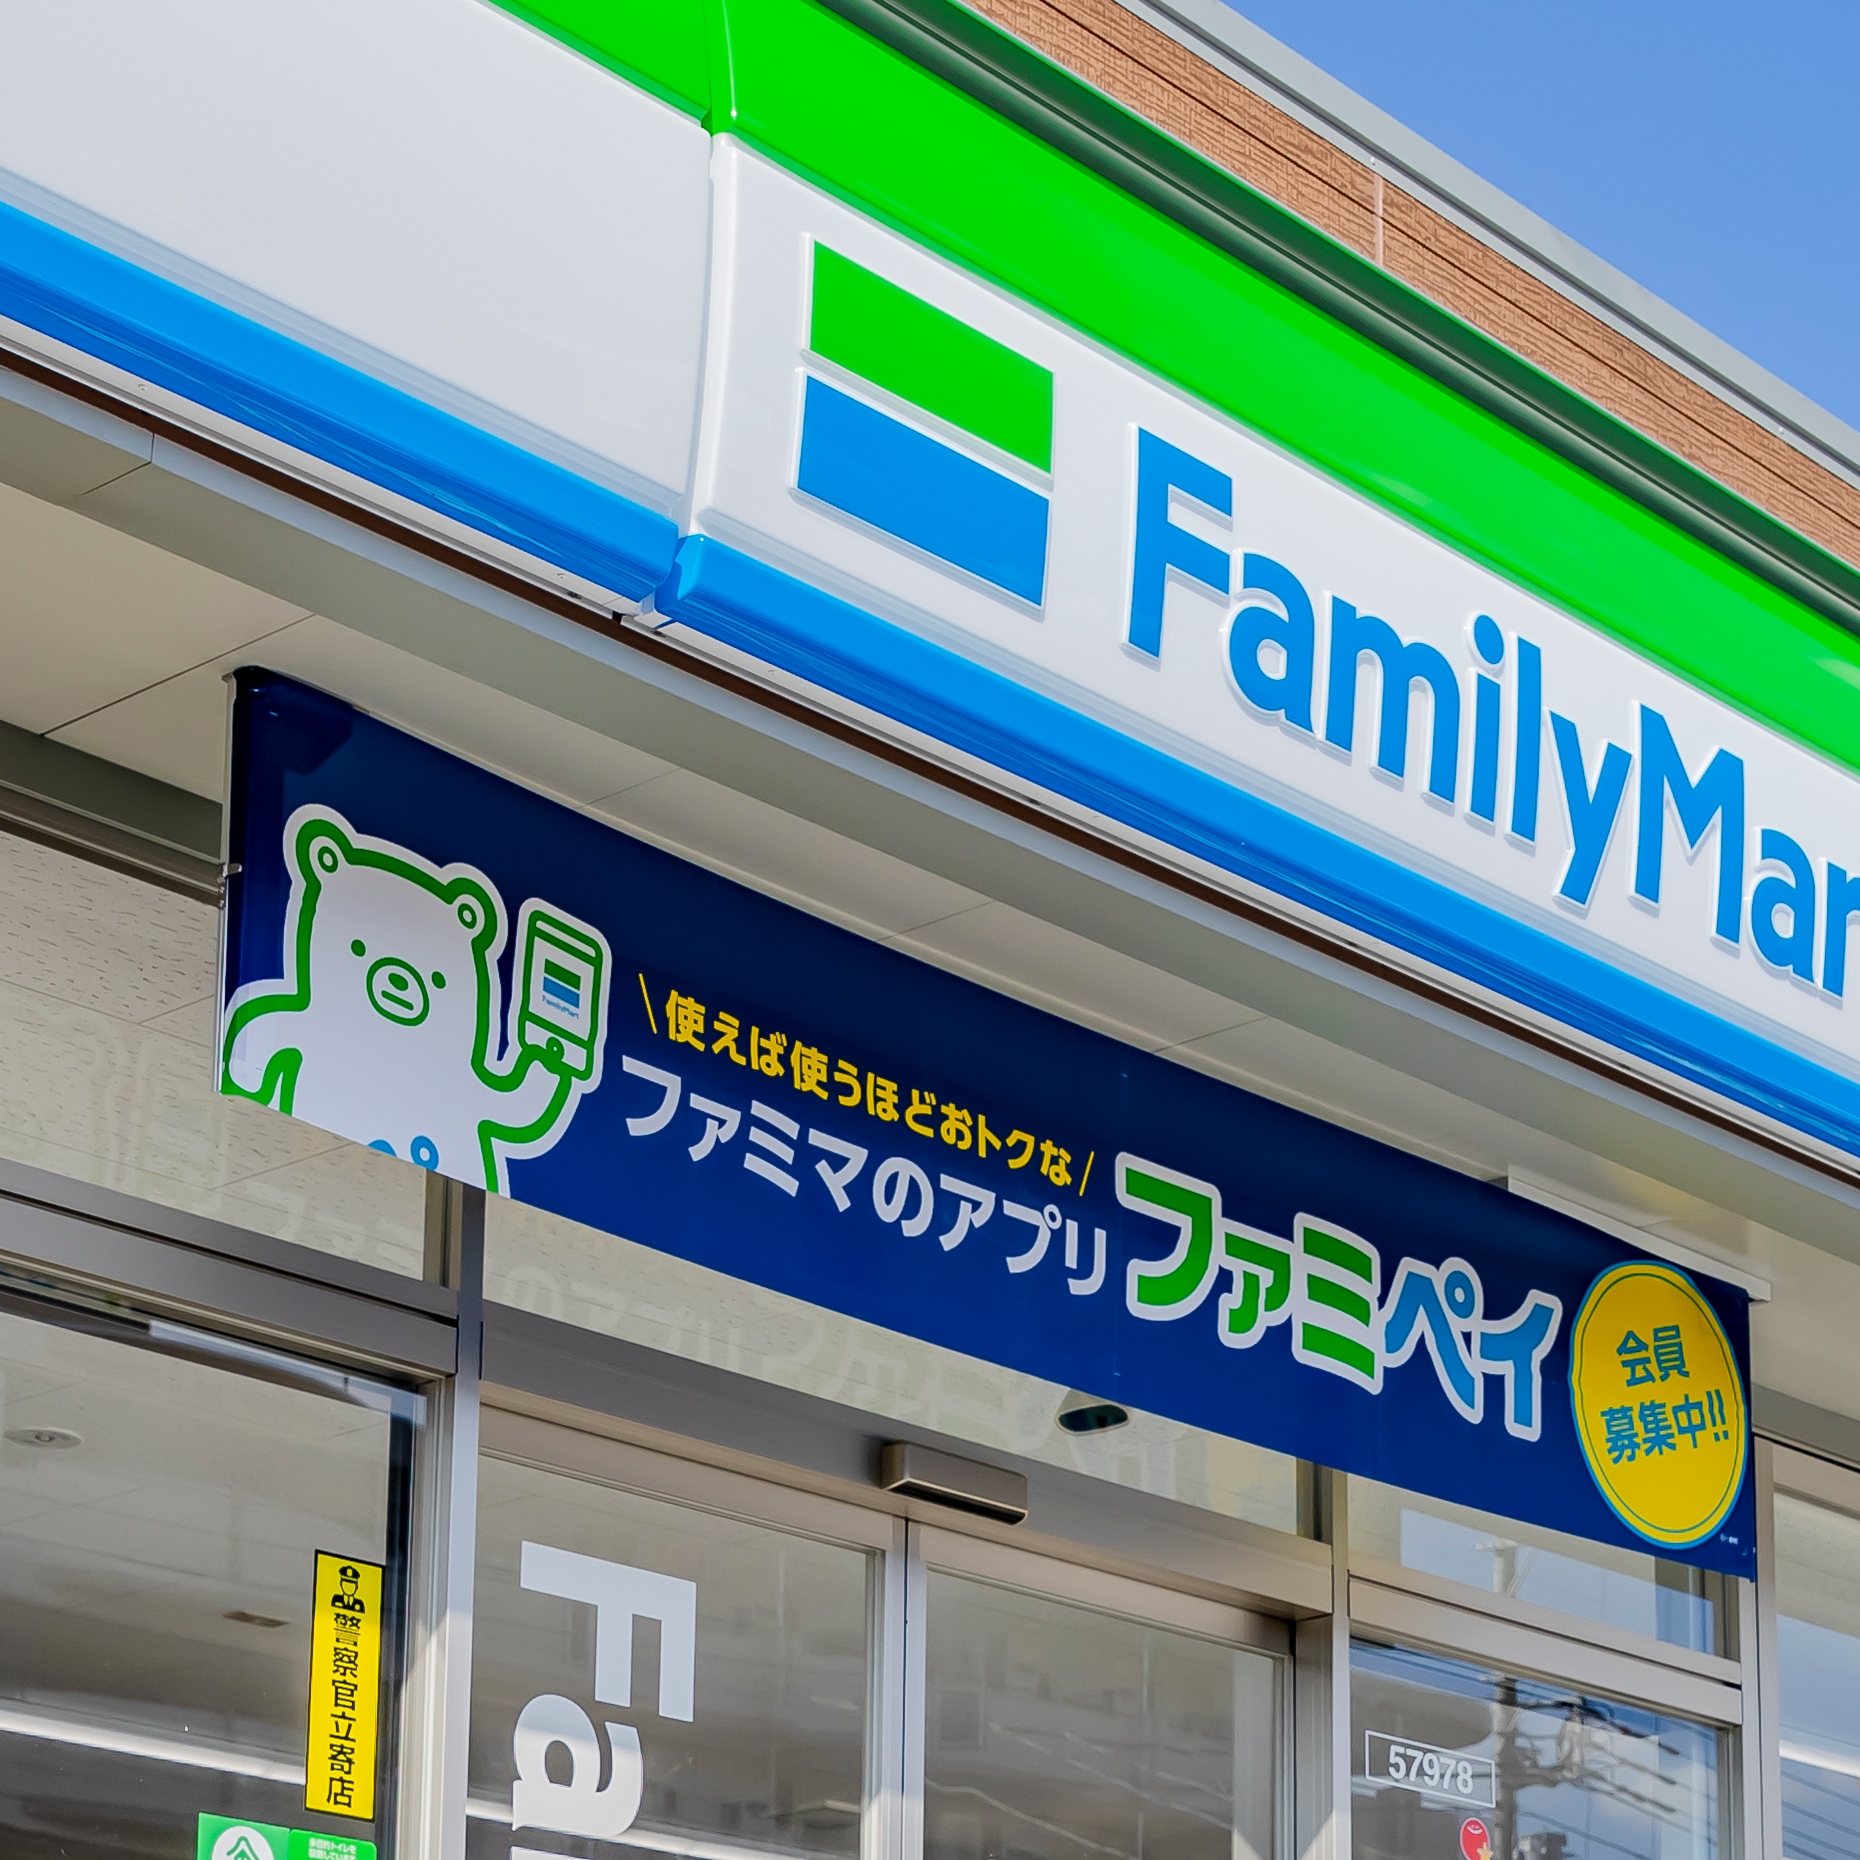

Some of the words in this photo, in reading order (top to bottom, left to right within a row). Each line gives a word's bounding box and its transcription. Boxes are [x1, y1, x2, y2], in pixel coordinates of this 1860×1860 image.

[621, 1054, 1107, 1296] ファミマのアプリ
[665, 989, 1073, 1187] 使えば使うほどおトクな
[1117, 1154, 1561, 1440] ファミペイ
[1615, 1324, 1690, 1387] 会員
[325, 1611, 362, 1809] 警察官立寄店
[1388, 1745, 1475, 1795] 57978
